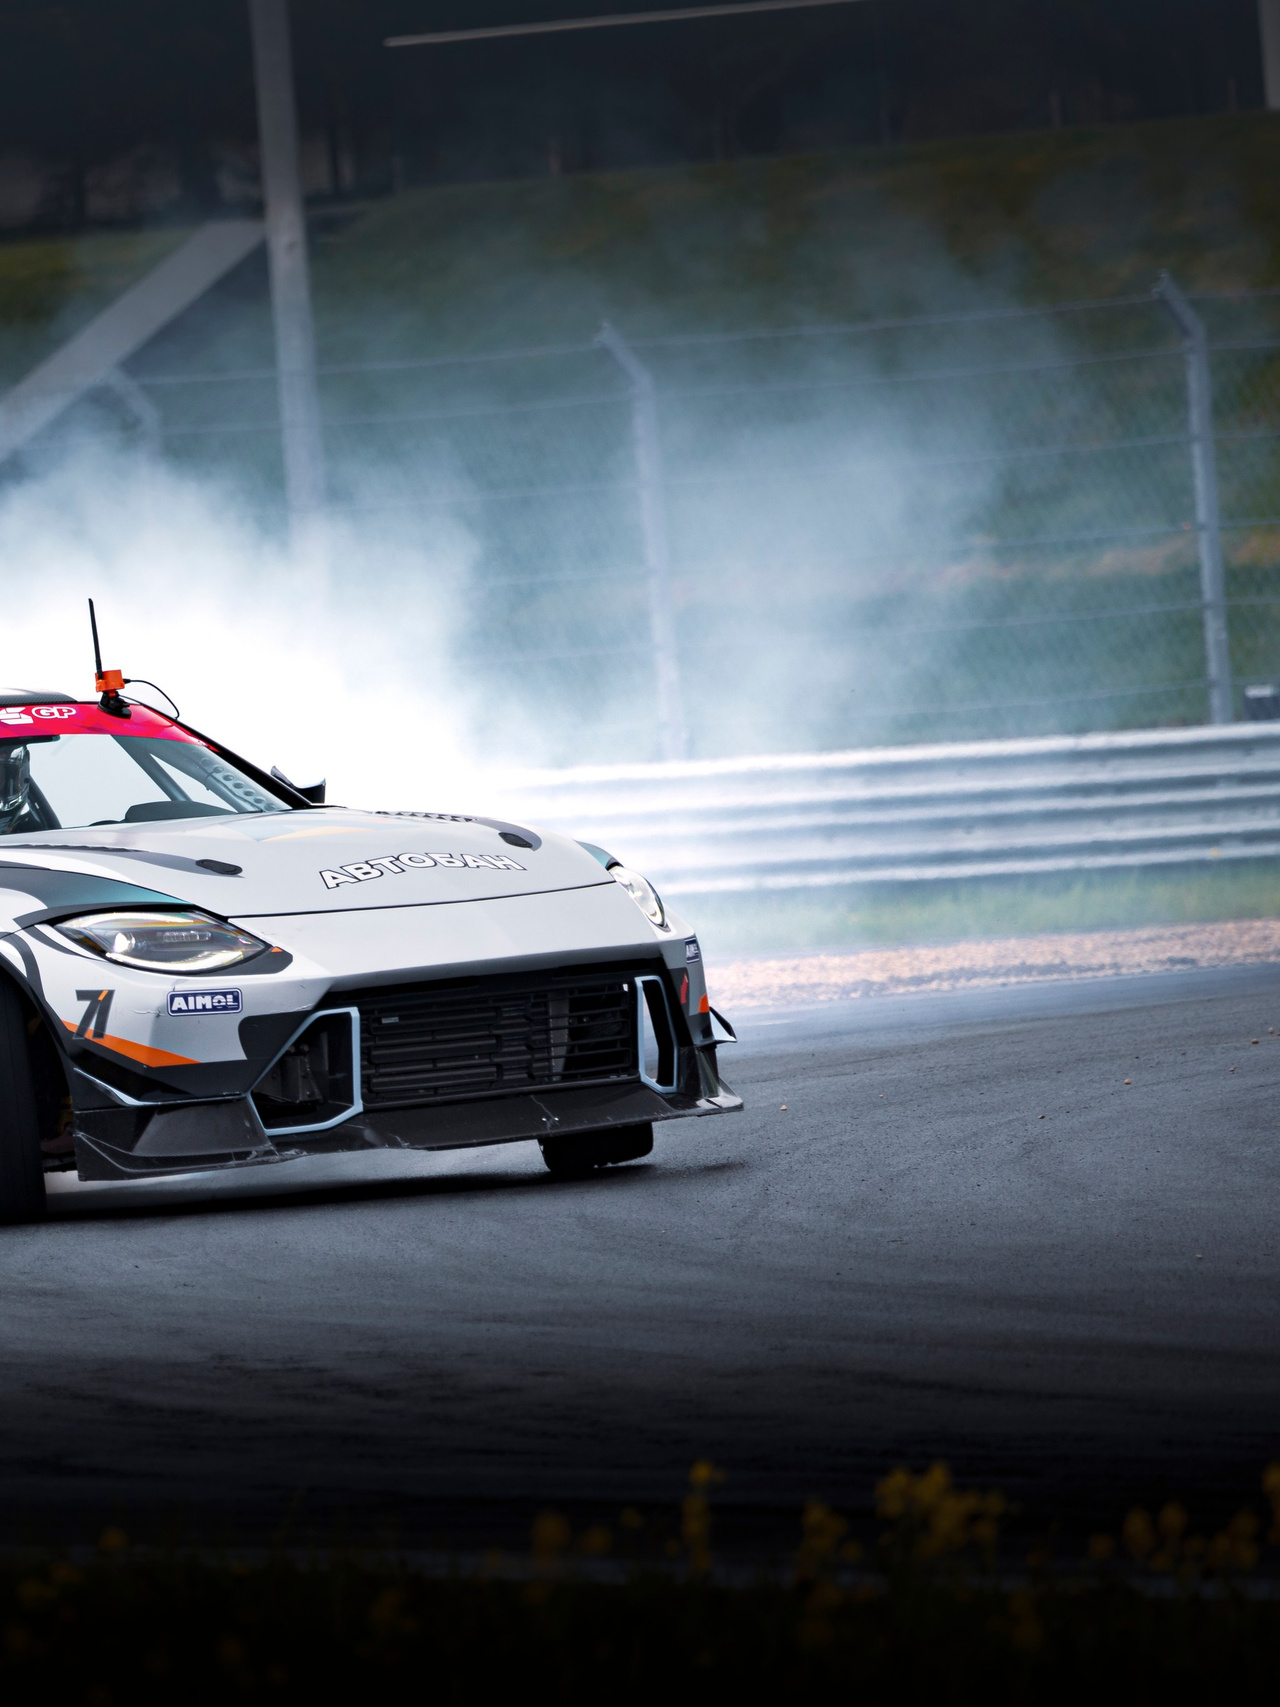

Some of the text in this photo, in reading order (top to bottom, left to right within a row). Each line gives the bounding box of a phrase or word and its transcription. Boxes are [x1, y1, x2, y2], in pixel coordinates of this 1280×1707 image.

[31, 706, 77, 719] GP
[319, 852, 527, 889] АВТОБАН
[171, 994, 238, 1011] AIMOL
